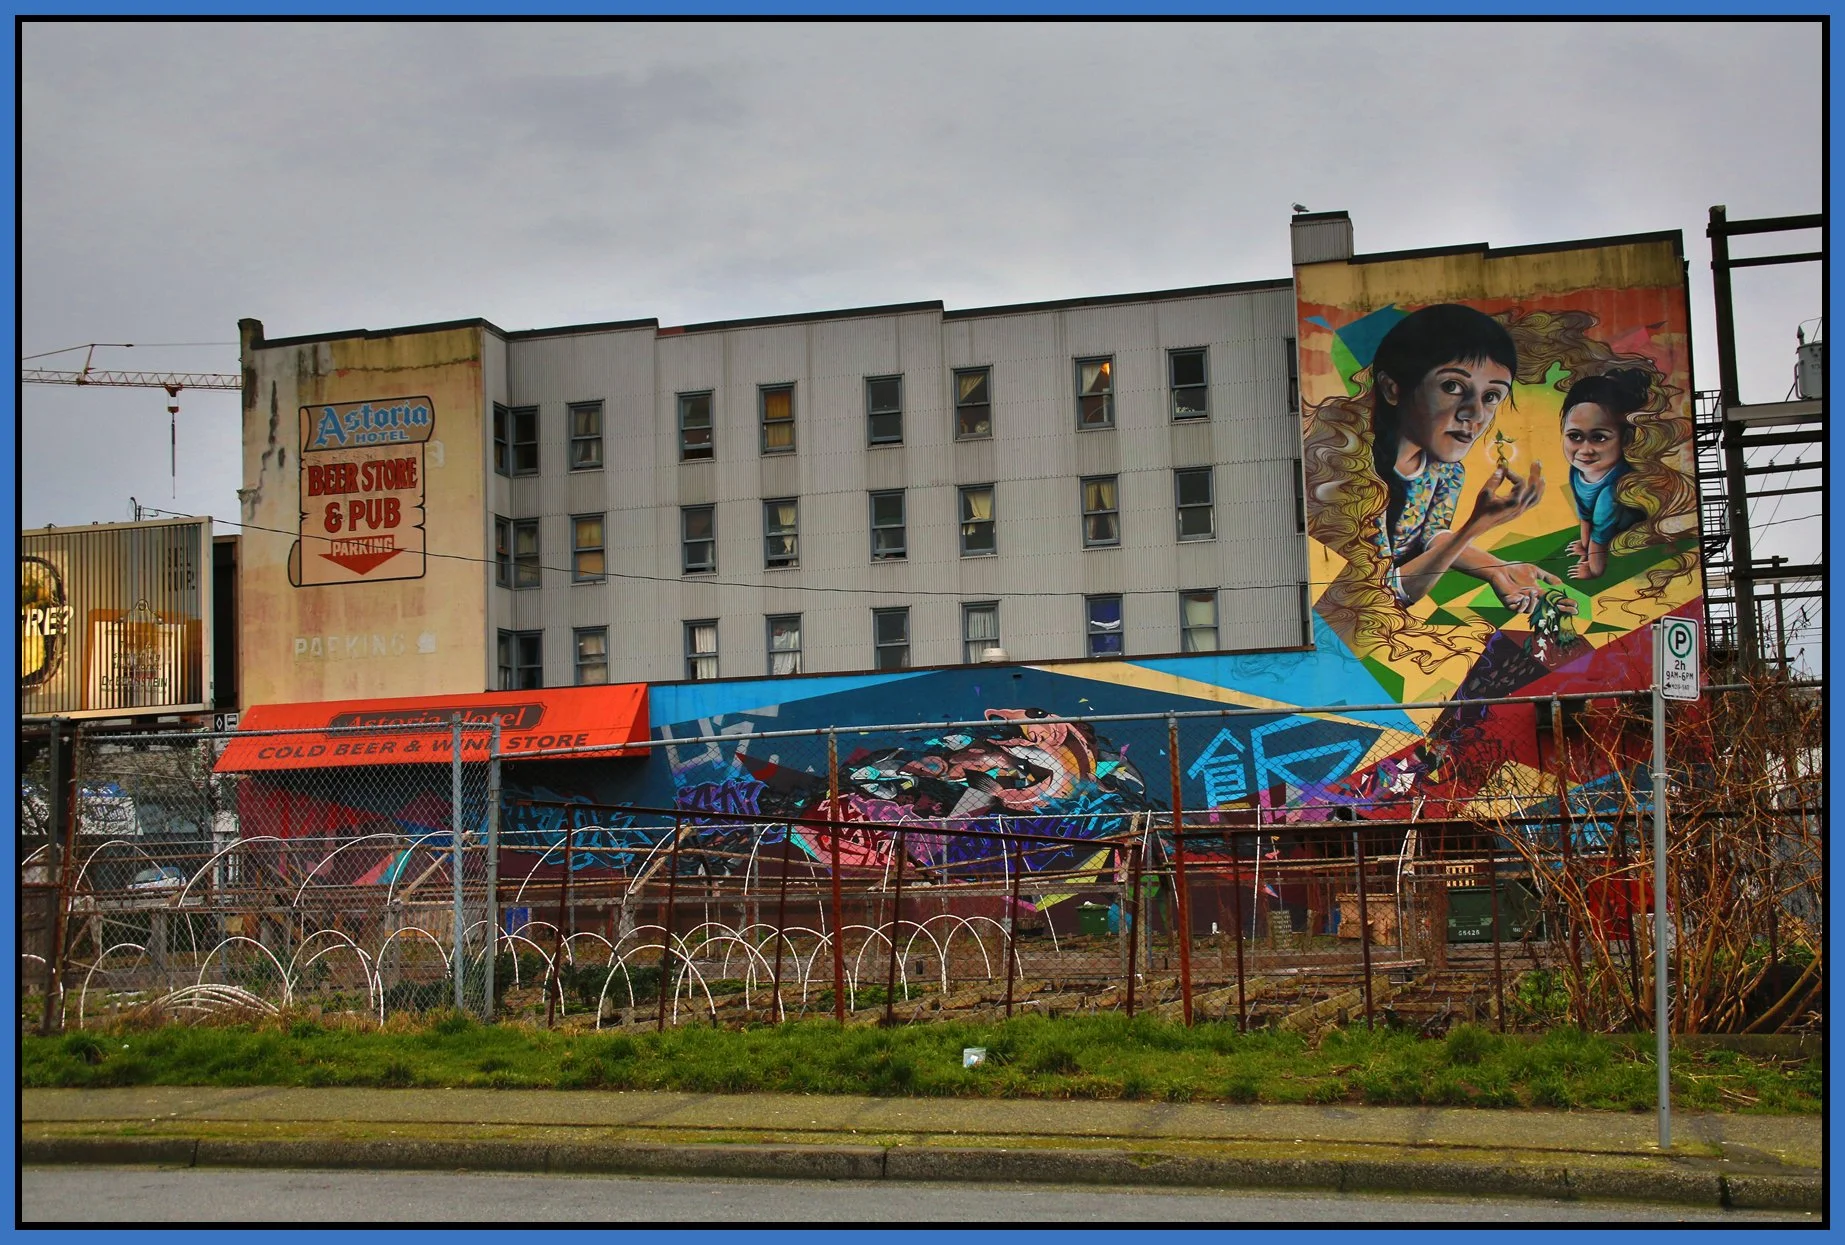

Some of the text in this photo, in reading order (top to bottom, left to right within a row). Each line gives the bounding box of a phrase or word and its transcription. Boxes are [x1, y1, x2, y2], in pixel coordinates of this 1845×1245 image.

[314, 400, 430, 447] Astoria
[356, 430, 409, 443] HOTEL
[308, 457, 418, 497] BEER STORE
[324, 497, 401, 533] & PUB
[332, 535, 393, 556] PARKING
[1675, 630, 1687, 650] P
[1674, 660, 1686, 670] 2h
[1666, 671, 1694, 681] 9AM-6PM
[257, 745, 326, 759] COLD
[333, 741, 396, 756] BEER
[403, 740, 420, 753] &
[506, 733, 589, 749] STORE
